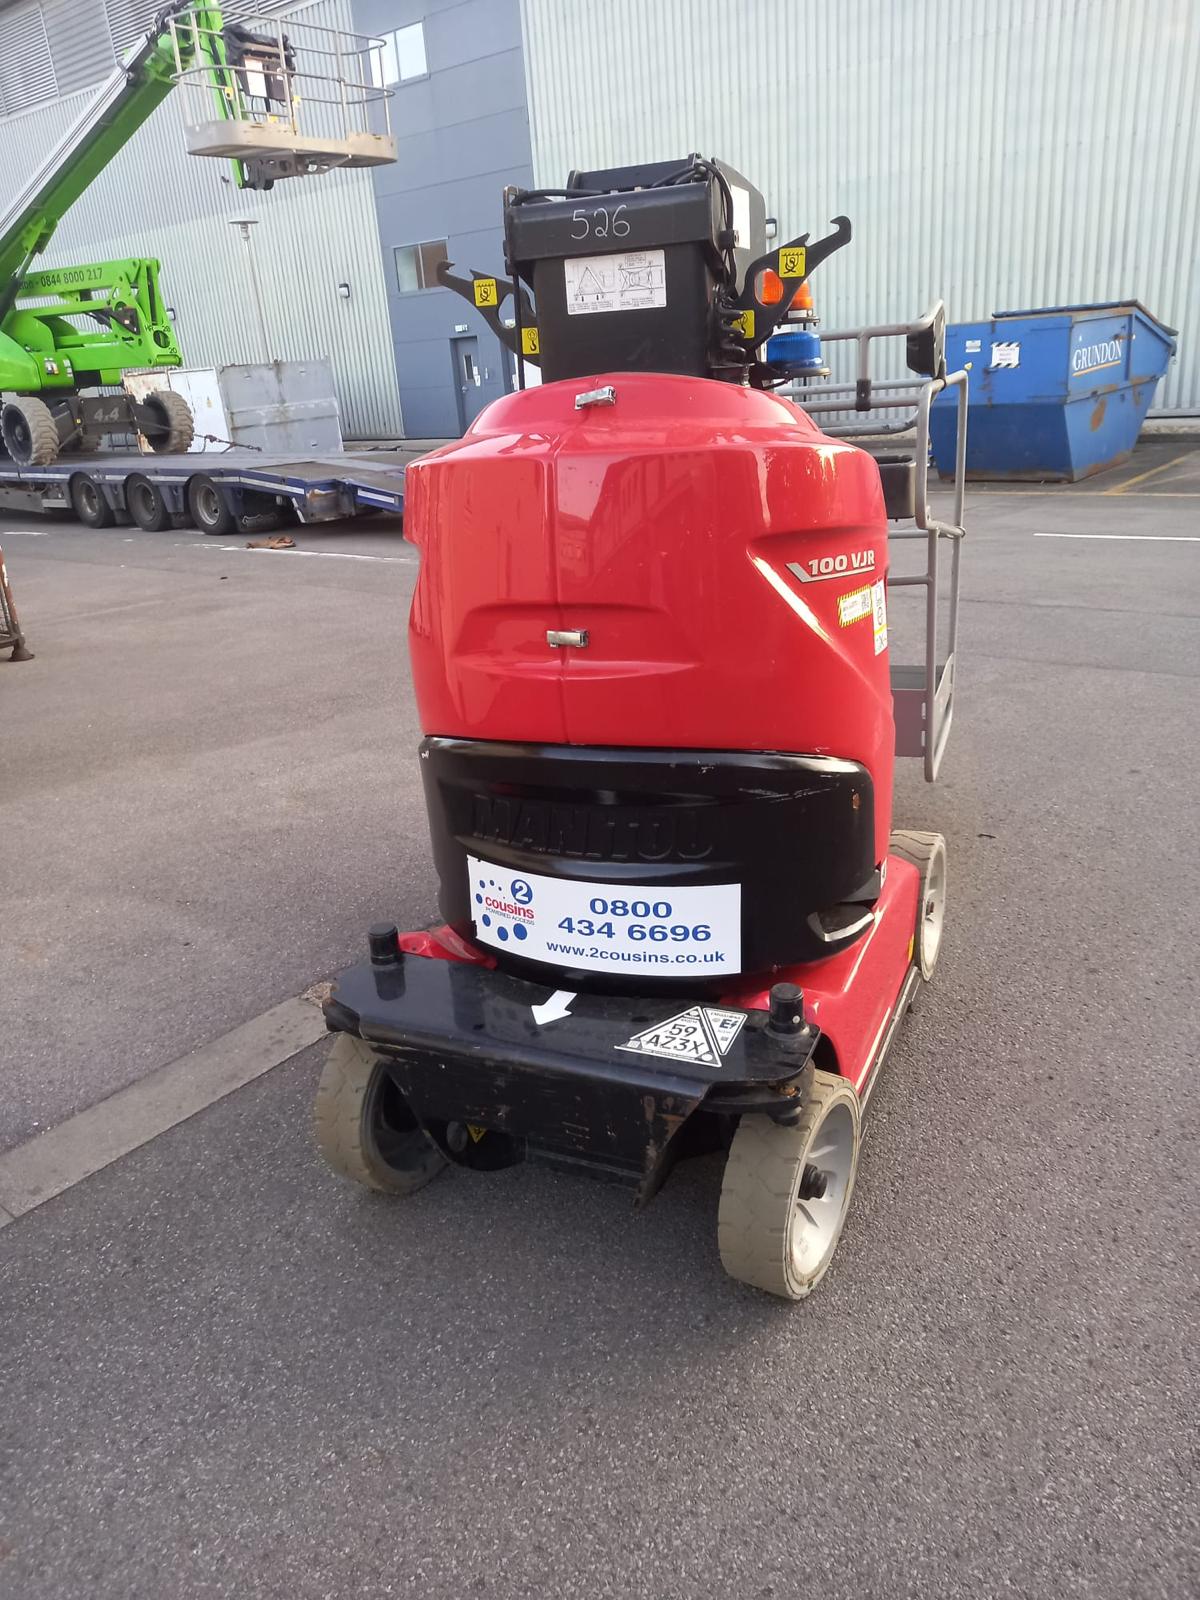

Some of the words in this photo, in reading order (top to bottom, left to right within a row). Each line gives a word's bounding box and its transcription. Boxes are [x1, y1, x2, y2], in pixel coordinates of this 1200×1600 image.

[571, 204, 630, 239] 526
[40, 273, 62, 287] 0844
[63, 270, 85, 284] 8000
[87, 267, 103, 280] 217
[1072, 339, 1122, 371] GRUNDON
[808, 554, 847, 575] 100
[851, 550, 875, 568] VJR
[514, 882, 529, 901] 2
[485, 896, 535, 919] cousins
[485, 906, 512, 919] POWERED
[512, 915, 535, 926] ACCESS
[589, 898, 673, 918] 0800
[558, 917, 616, 938] 434
[627, 924, 712, 942] 6696
[546, 941, 726, 963] www.2cousins.co.uk
[668, 1023, 698, 1037] 59
[645, 1034, 704, 1054] AZ3X
